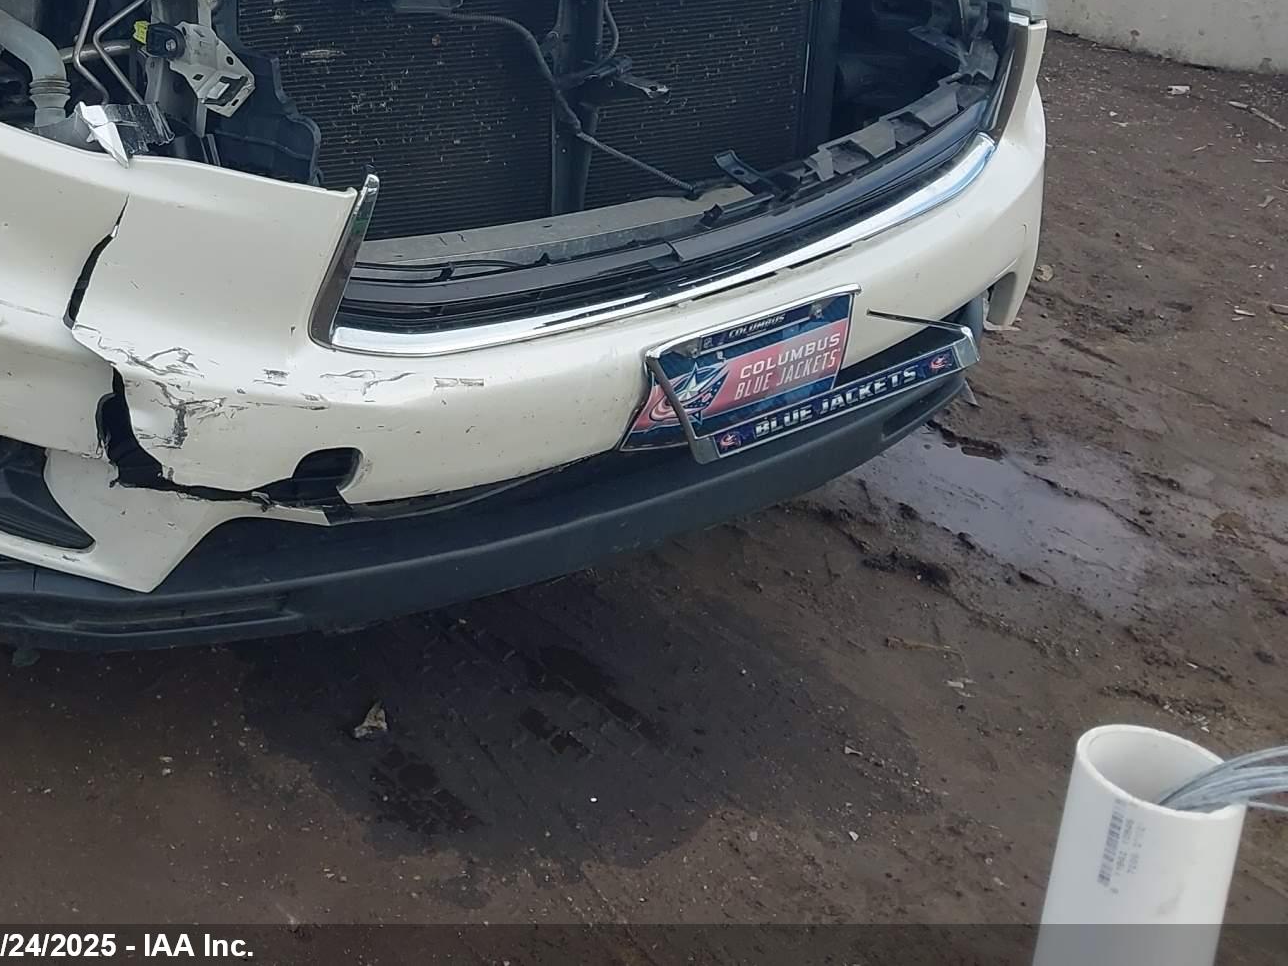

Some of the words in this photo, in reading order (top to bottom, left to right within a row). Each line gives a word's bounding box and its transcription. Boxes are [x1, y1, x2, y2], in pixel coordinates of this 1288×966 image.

[727, 313, 786, 338] COLUMBUS
[734, 373, 775, 401] BLUE
[777, 349, 837, 385] JACKETS
[740, 332, 841, 379] COLUMBUS
[754, 406, 813, 438] BLUE
[819, 365, 919, 415] JACKETS
